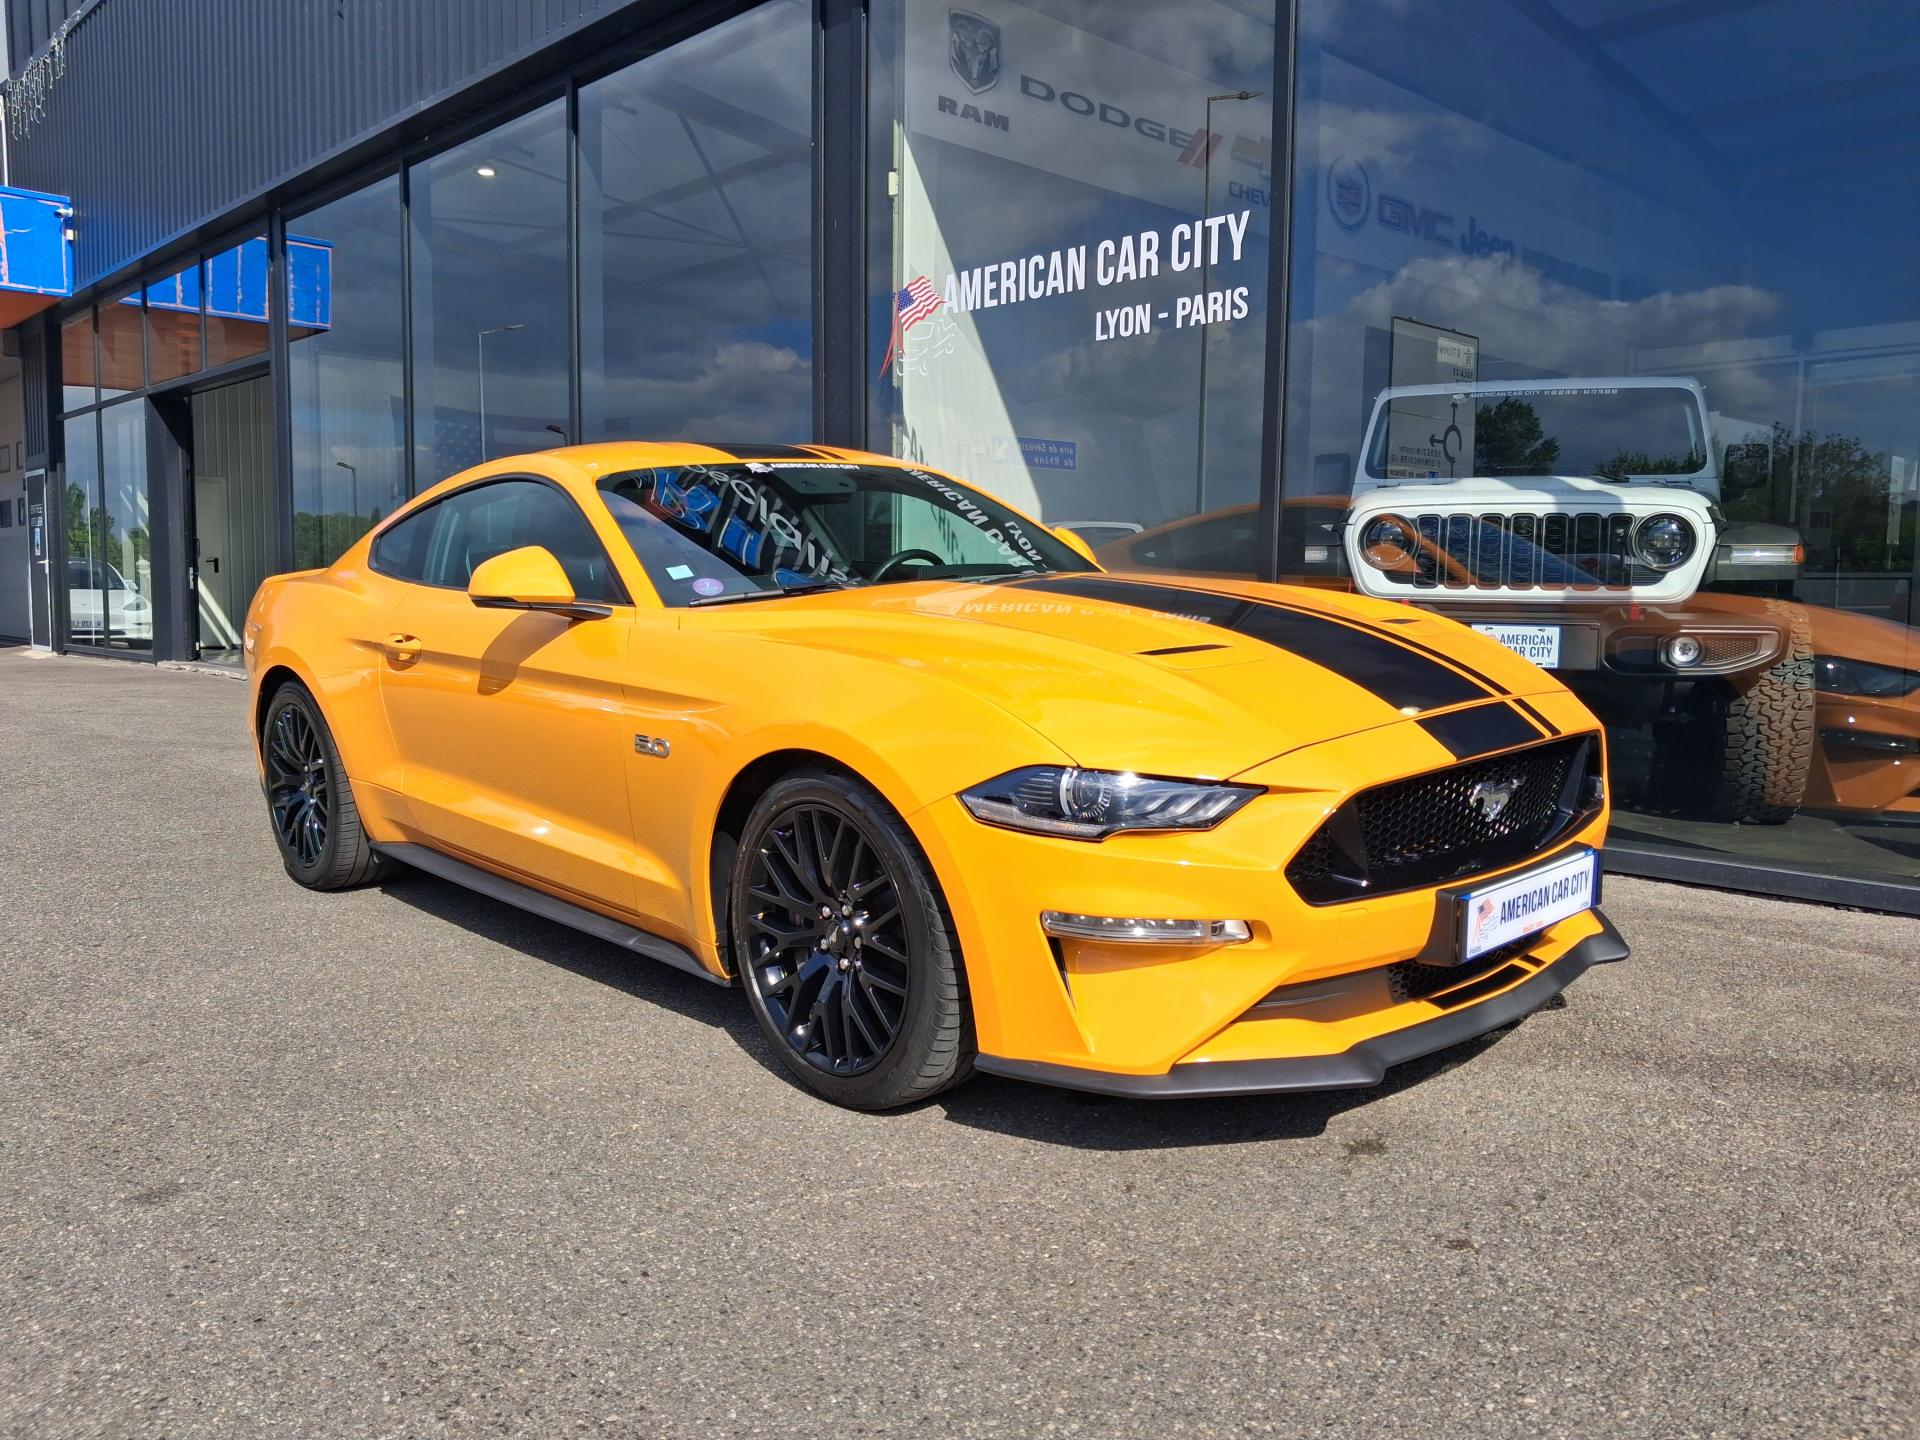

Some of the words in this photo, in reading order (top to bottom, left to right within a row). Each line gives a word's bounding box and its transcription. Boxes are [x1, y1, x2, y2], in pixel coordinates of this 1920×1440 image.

[937, 95, 1010, 133] RAM
[1019, 74, 1199, 151] DODGE
[1377, 192, 1455, 248] GMC
[942, 244, 1087, 315] AMERICAN
[1097, 230, 1159, 287] CAR
[1171, 210, 1251, 273] CITY
[1095, 302, 1151, 342] LYON
[1176, 286, 1250, 329] PARIS
[1499, 634, 1553, 646] AMERICAN
[1529, 646, 1553, 658] CITY
[1500, 884, 1551, 925] AMERICAN
[1551, 879, 1570, 904] CAR
[1570, 868, 1591, 896] CITY
